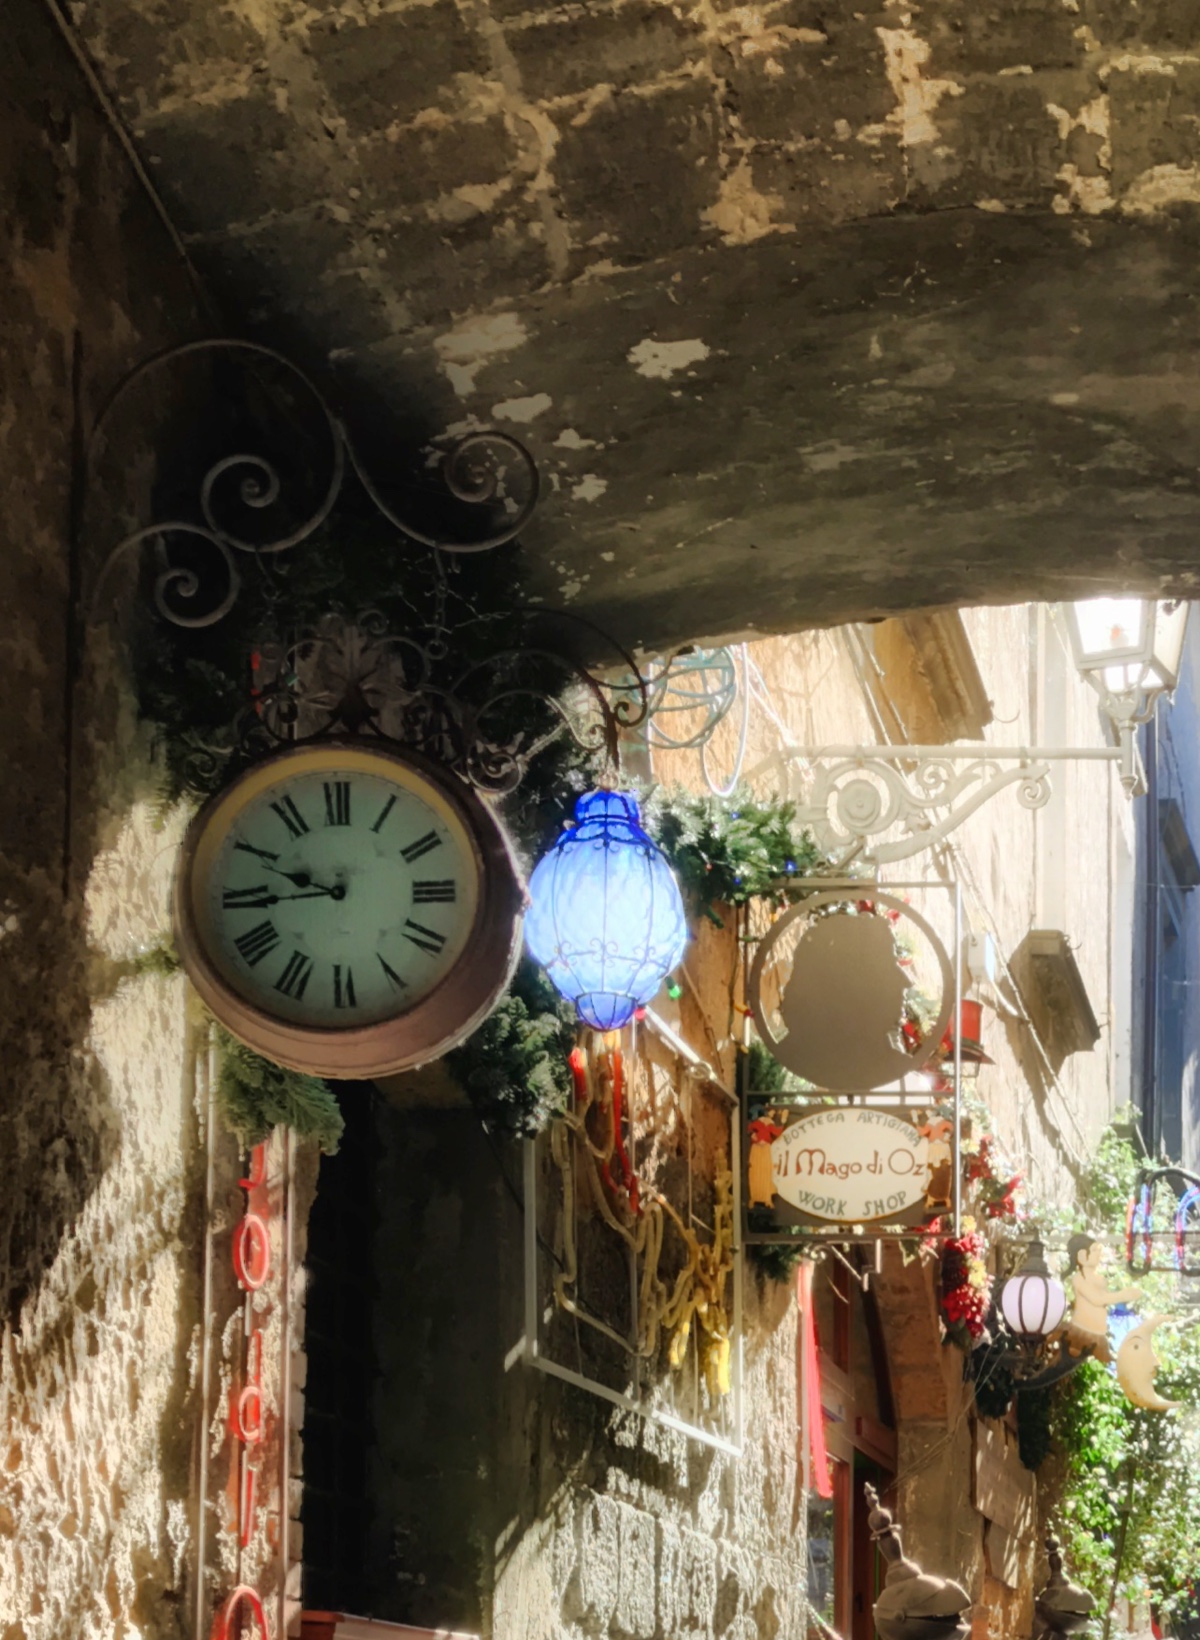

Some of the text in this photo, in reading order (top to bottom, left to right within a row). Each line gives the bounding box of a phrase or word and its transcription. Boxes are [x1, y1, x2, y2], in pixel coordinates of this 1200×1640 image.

[270, 794, 311, 842] XI
[323, 781, 351, 827] XII
[370, 794, 397, 833] I
[400, 830, 442, 864] II
[412, 879, 456, 904] III
[233, 920, 283, 968] VIII
[400, 918, 447, 960] IV
[273, 950, 315, 1001] VII
[332, 964, 357, 1008] VI
[376, 952, 408, 994] V
[783, 1112, 922, 1147] BOTTEGA ARTIGIANA
[777, 1148, 925, 1180] il Mago di Oz
[798, 1190, 907, 1216] WORK SHOP
